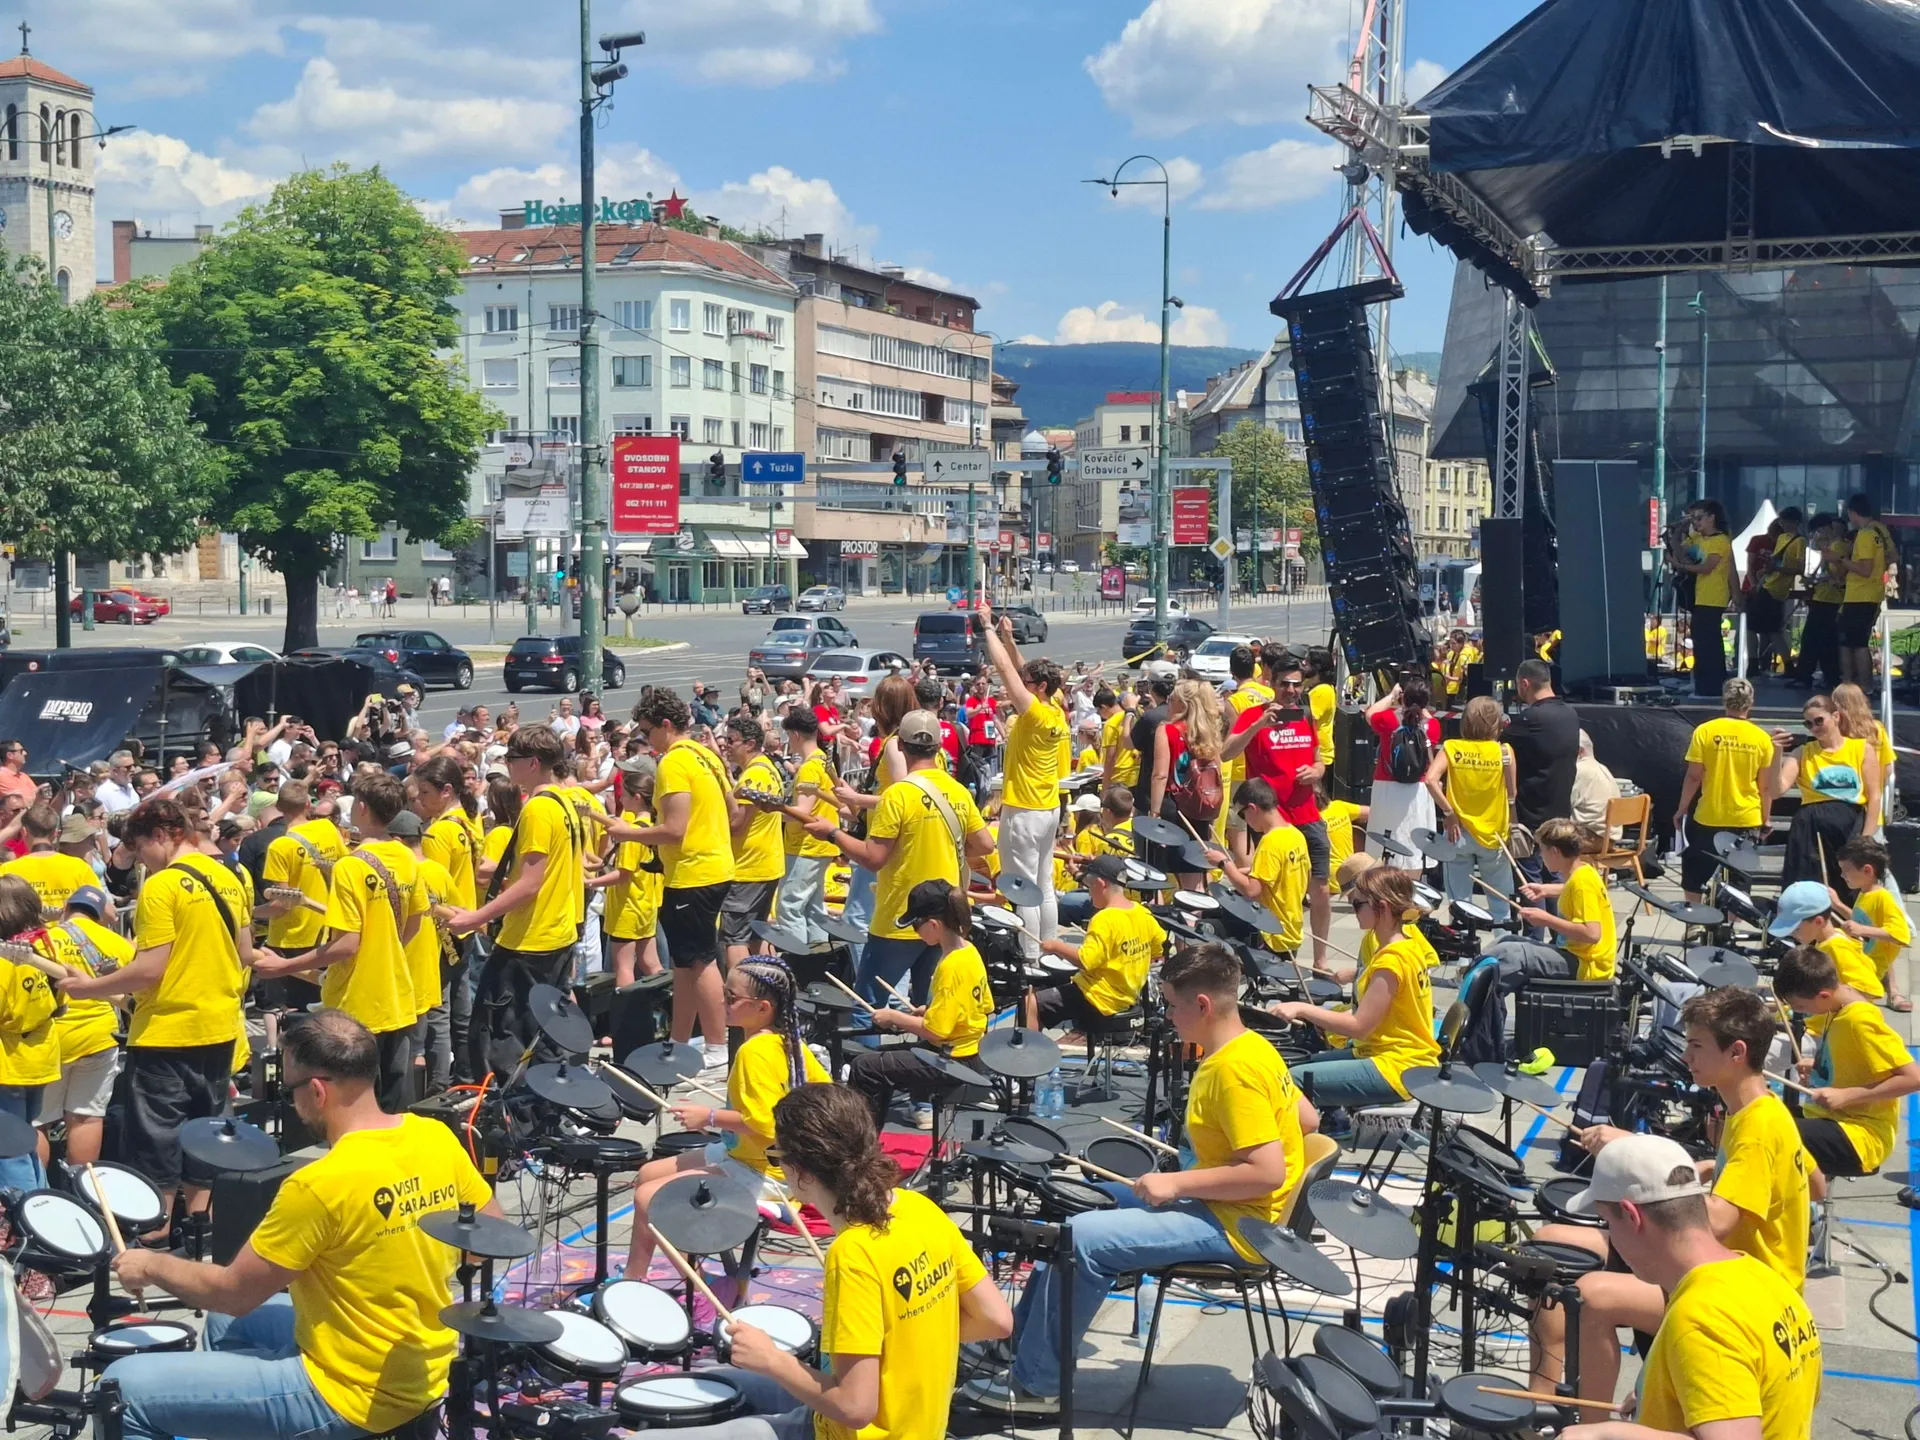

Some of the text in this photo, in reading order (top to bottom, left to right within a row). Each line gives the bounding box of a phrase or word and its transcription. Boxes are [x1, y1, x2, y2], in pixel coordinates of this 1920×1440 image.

[769, 463, 795, 472] Tuzla
[950, 462, 982, 470] Centar
[1084, 465, 1128, 474] Grbavica
[840, 540, 878, 554] PROSTOR
[43, 699, 93, 716] IMPERIO
[1462, 759, 1500, 767] SARAJEVO
[393, 1177, 420, 1196] VISIT
[376, 1192, 392, 1205] SA
[399, 1184, 455, 1216] SARAJEVO
[376, 1225, 406, 1238] where
[896, 1272, 911, 1287] SA
[897, 1305, 925, 1320] where
